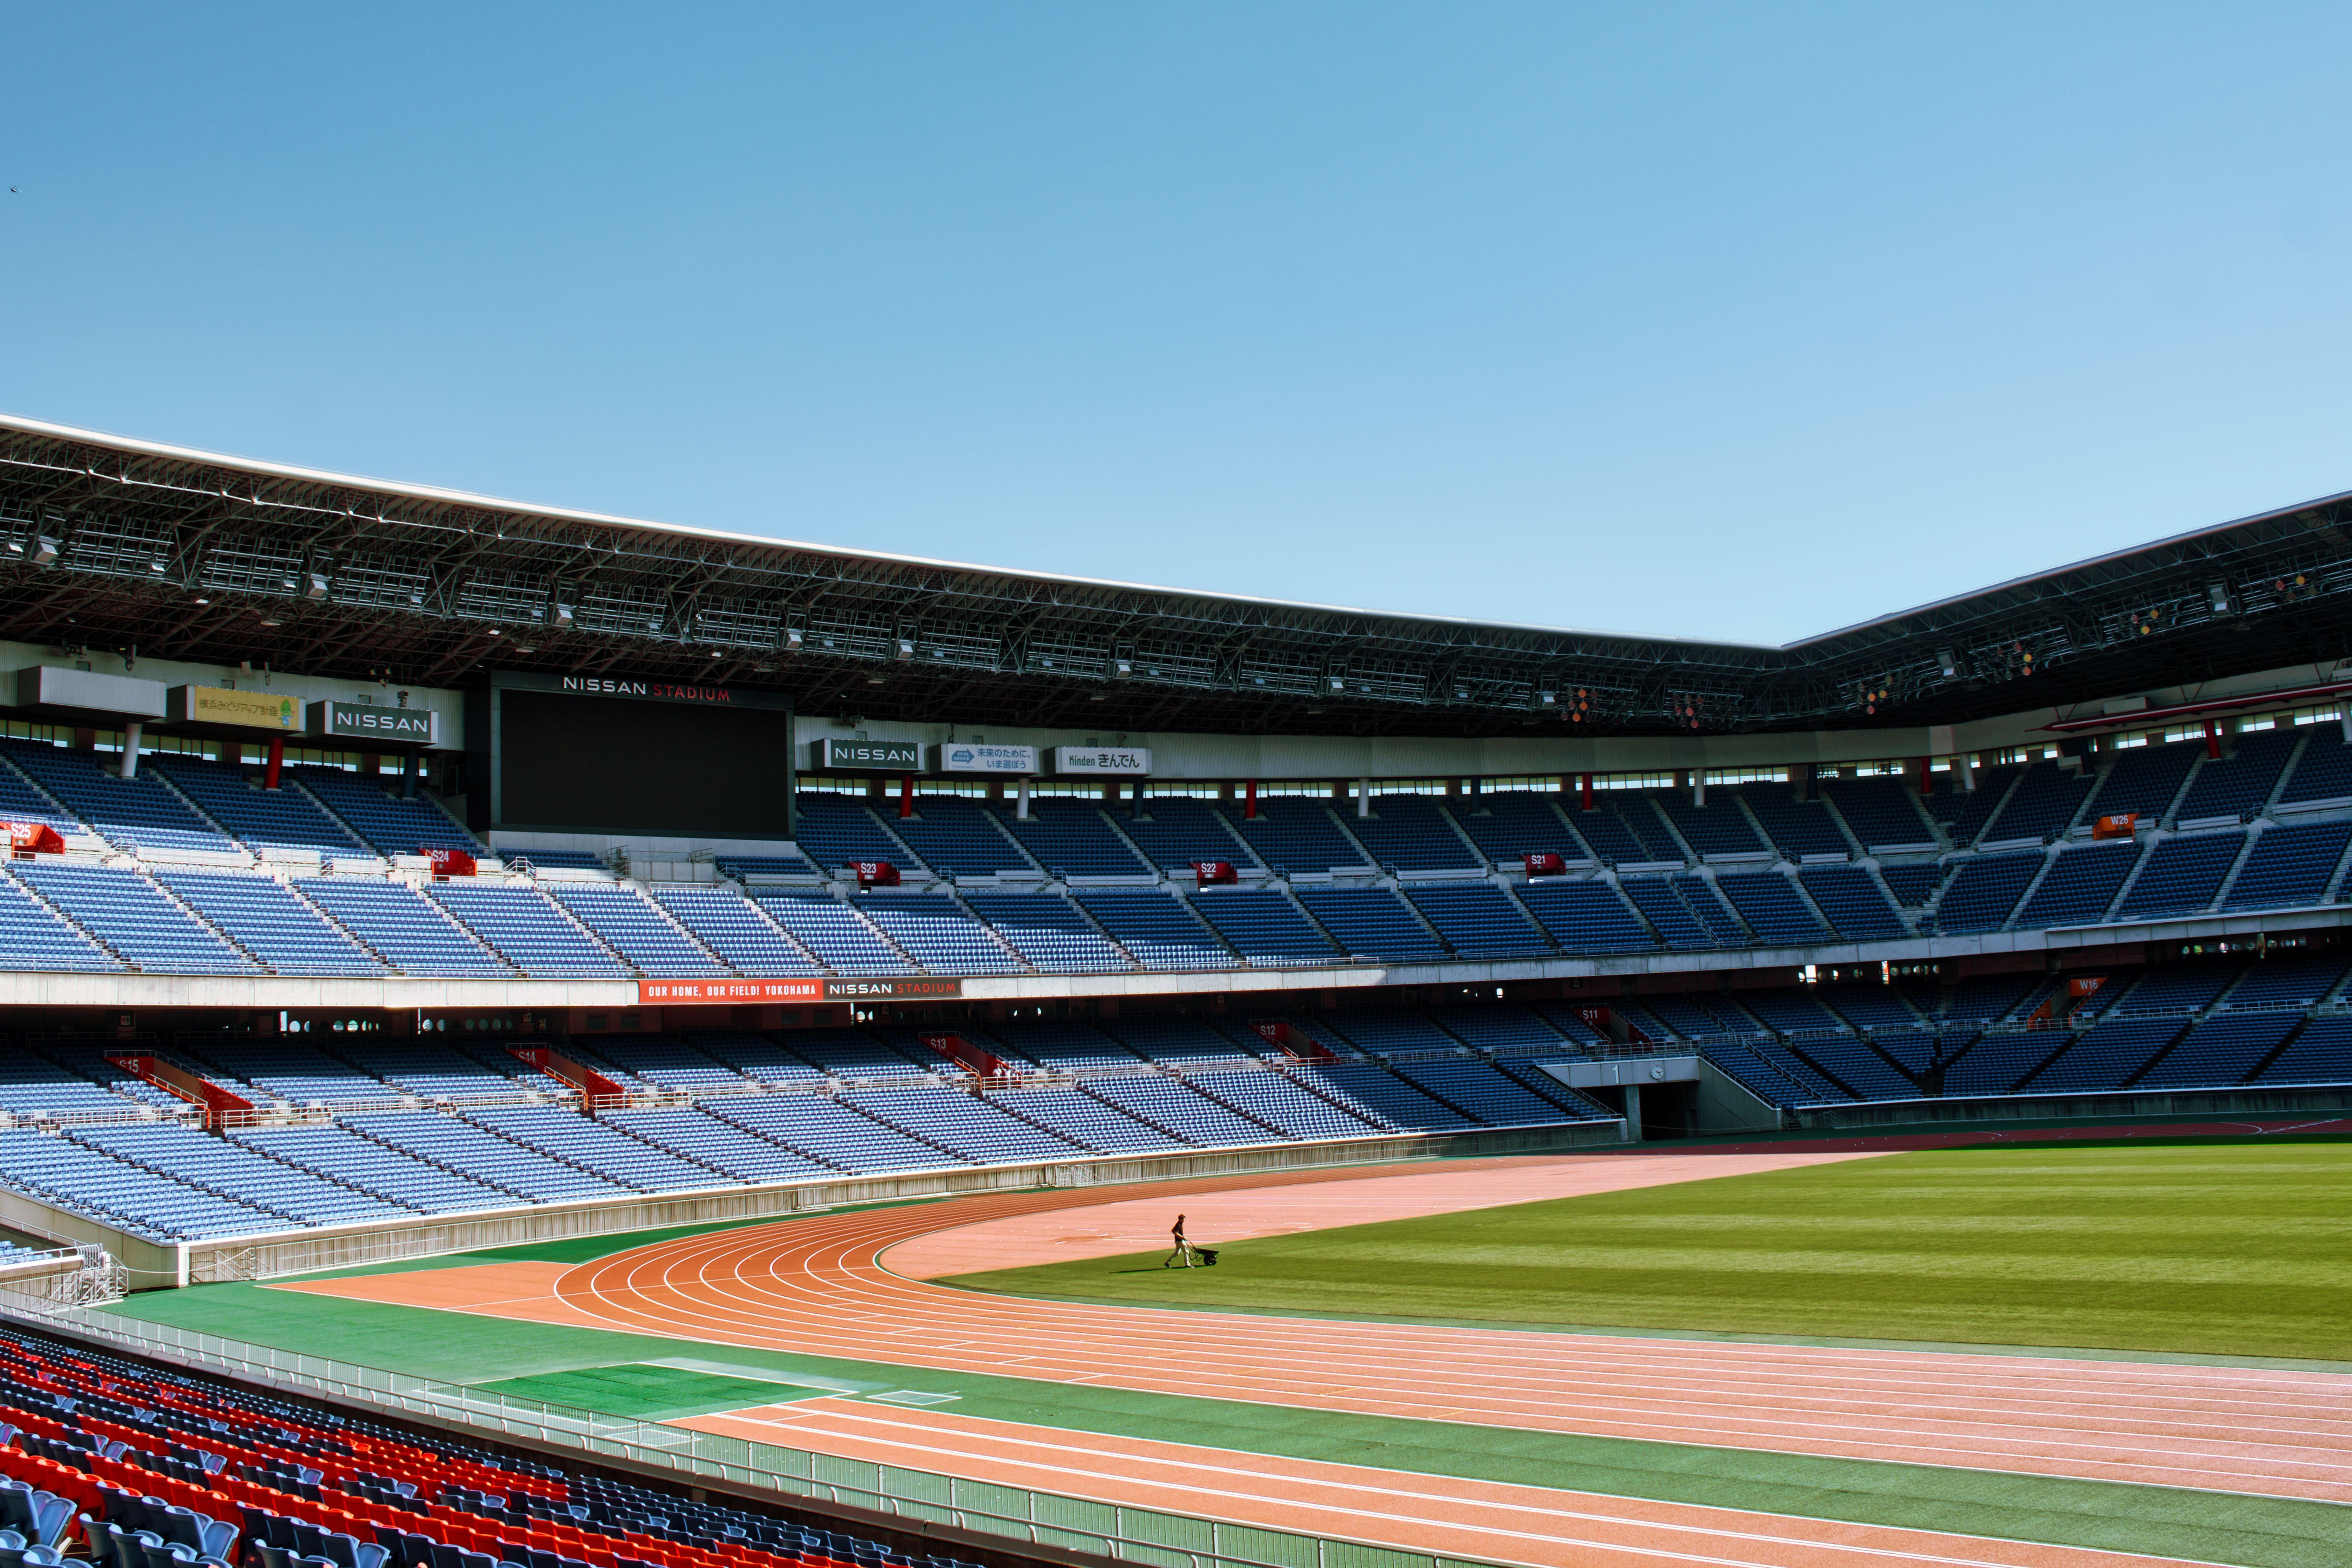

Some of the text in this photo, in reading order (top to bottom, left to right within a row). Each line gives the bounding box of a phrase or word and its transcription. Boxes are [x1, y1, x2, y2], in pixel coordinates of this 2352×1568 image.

[563, 677, 730, 702] NISSAN STADIUM
[199, 699, 278, 716] 横浜みどりアップ計画
[337, 712, 427, 732] NISSAN
[835, 748, 915, 762] NISSAN
[977, 748, 1031, 758] 未来のために、
[987, 760, 1026, 769] いま選ぼう
[1069, 754, 1140, 768] Kinden きんでん
[2110, 815, 2129, 825] W26
[11, 823, 31, 838] S25
[432, 850, 450, 862] S24
[1531, 855, 1545, 864] S21
[861, 863, 876, 874] S23
[1201, 863, 1216, 873] S22
[829, 983, 956, 994] NISSAN STADIUM
[2079, 979, 2098, 990] W16
[648, 985, 816, 998] OUR HOME, OUR FIELD! YOKOHAMA
[1583, 1009, 1598, 1019] S11
[1260, 1025, 1276, 1035] S12
[1612, 1064, 1620, 1084] 1
